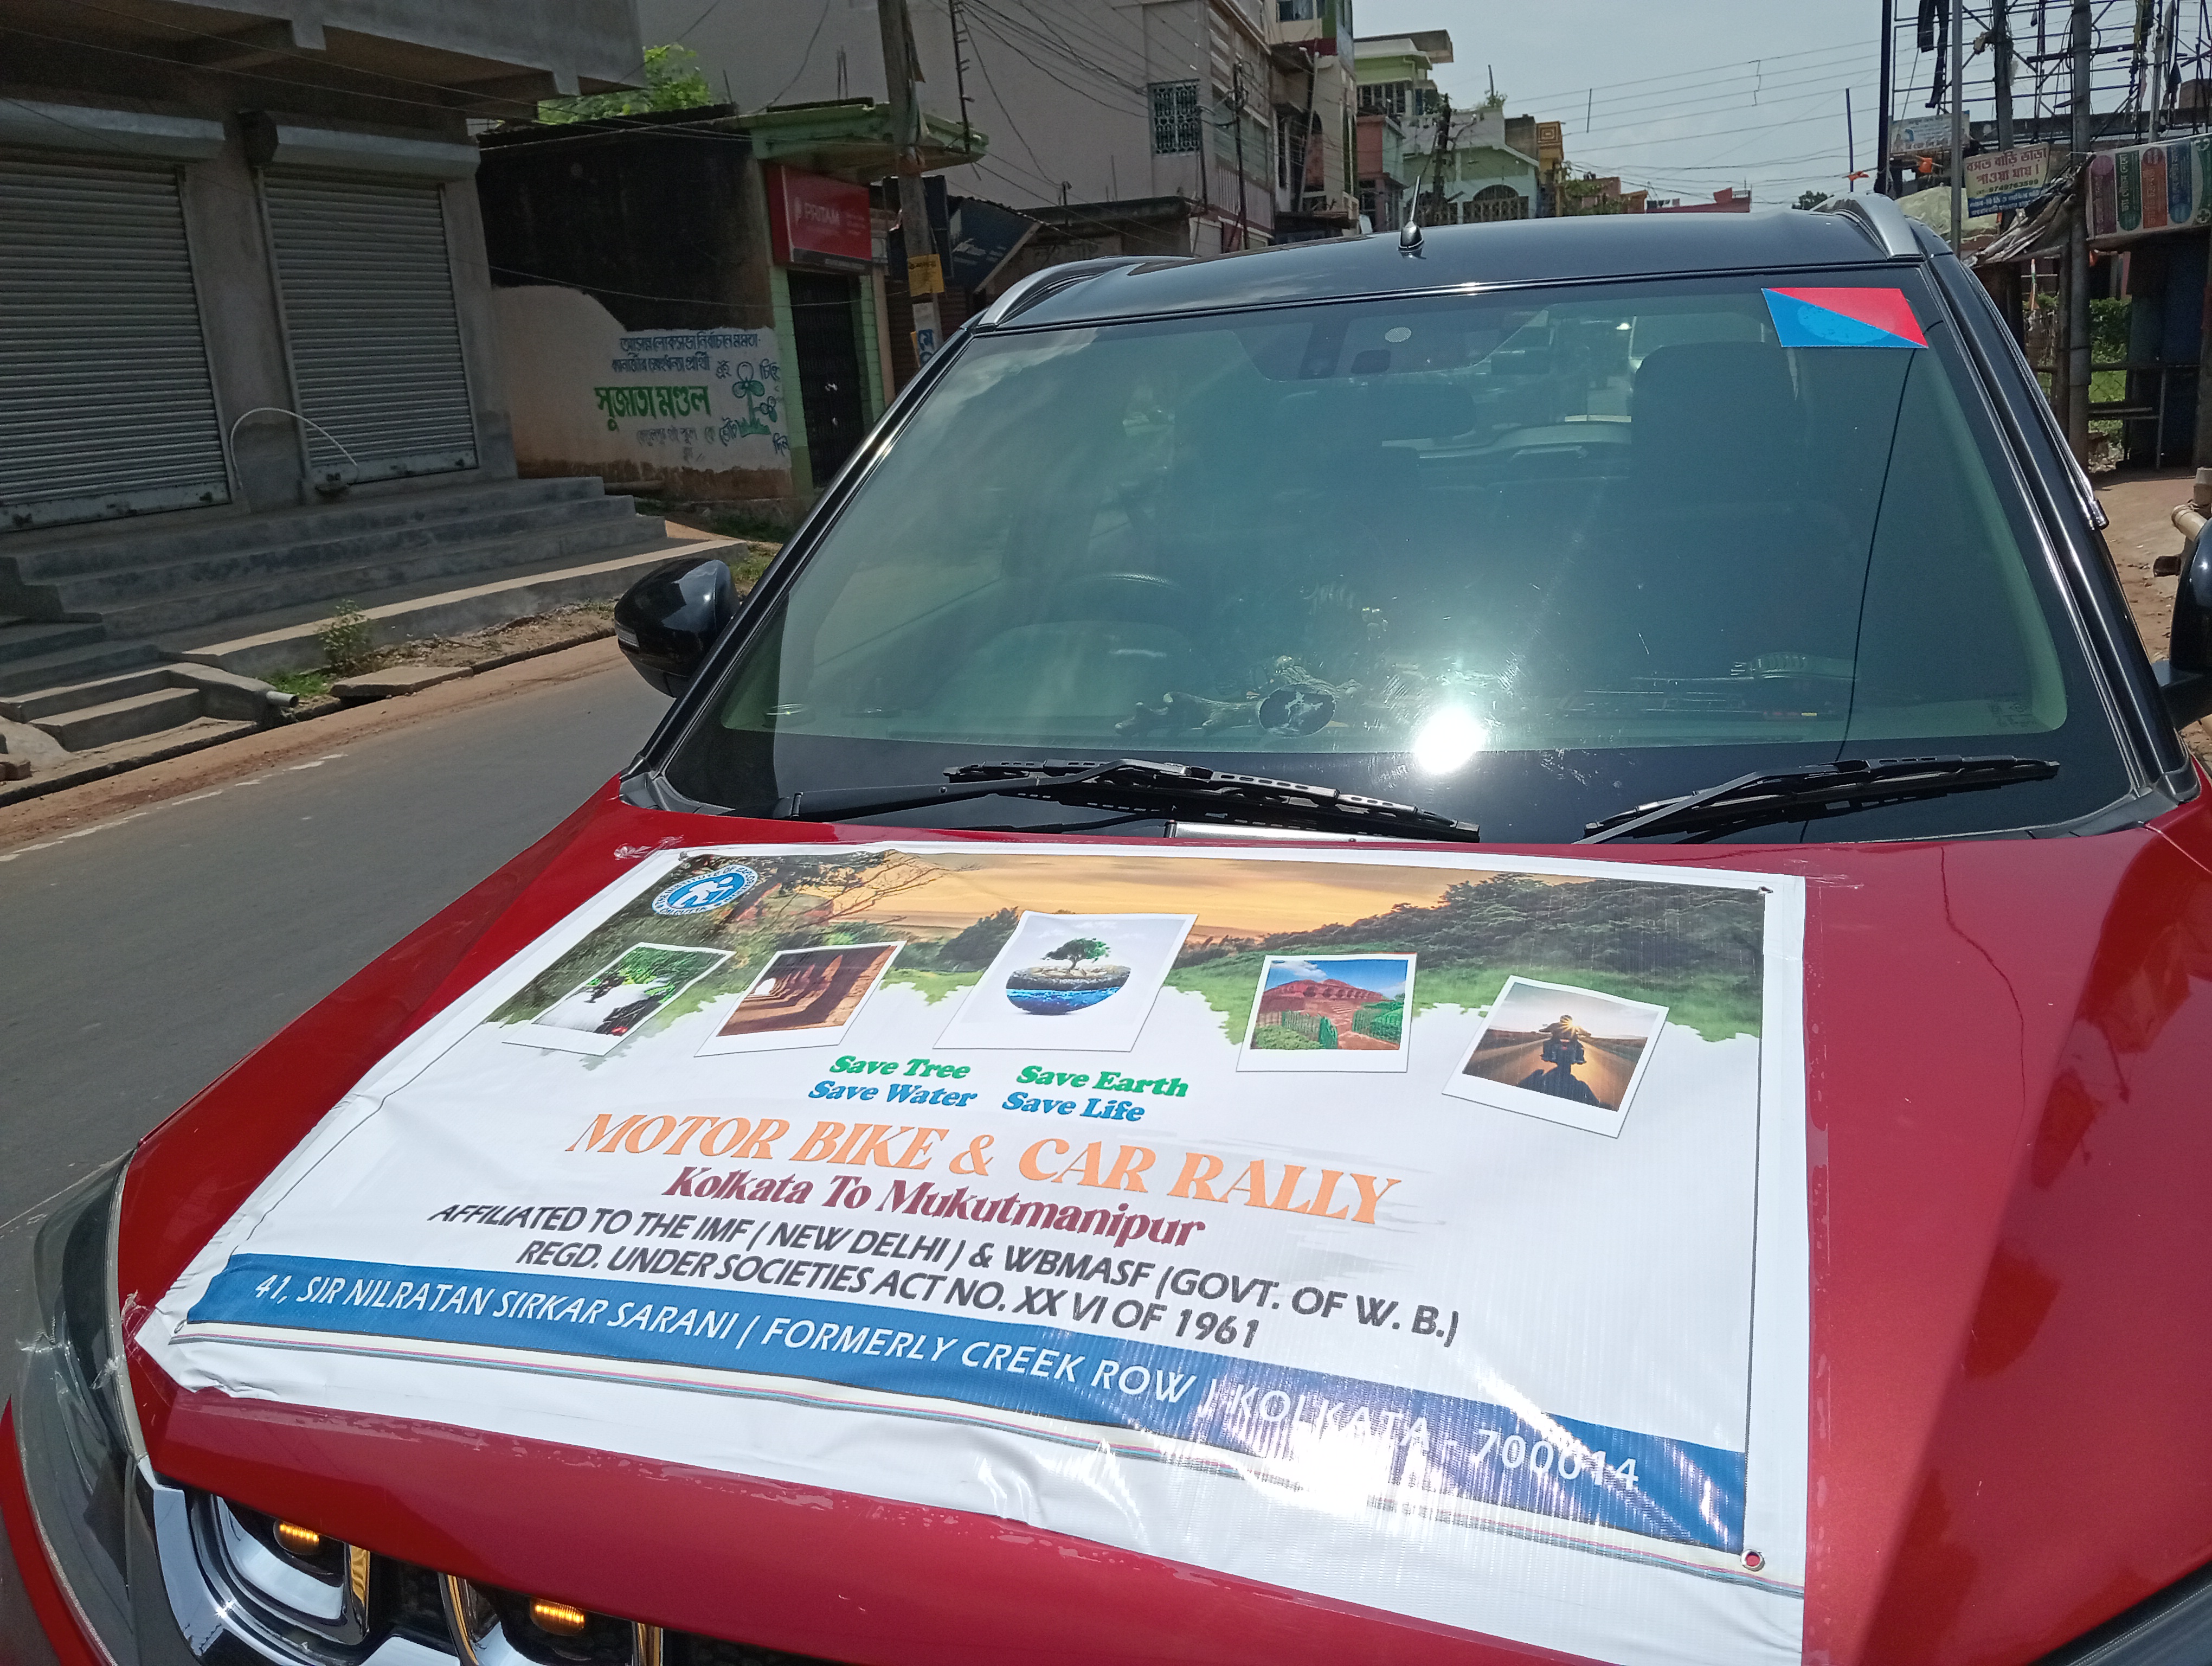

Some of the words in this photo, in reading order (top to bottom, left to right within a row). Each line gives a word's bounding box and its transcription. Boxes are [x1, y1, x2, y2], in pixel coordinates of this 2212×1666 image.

[594, 385, 657, 432] সুজাতা
[809, 1080, 879, 1100] Save
[886, 1084, 978, 1107] Water
[829, 1055, 899, 1076] Save
[902, 1057, 972, 1079] Tree
[1017, 1065, 1090, 1090] Save
[1092, 1072, 1189, 1098] Earth
[1002, 1092, 1076, 1116] Save
[1081, 1098, 1146, 1122] Life
[565, 1113, 790, 1159] MOTOR
[789, 1120, 950, 1170] BIKE
[949, 1134, 996, 1176] &
[1019, 1138, 1156, 1193] CAR
[1167, 1152, 1402, 1225] RALLY
[662, 1166, 814, 1204] Kolkata
[822, 1175, 872, 1209] To
[874, 1179, 1206, 1248] Mukutmanipur
[427, 1203, 588, 1235] AFFILIATED
[586, 1208, 633, 1235] TO
[633, 1210, 695, 1239] THE
[692, 1215, 755, 1242] IMF
[968, 1242, 993, 1268] &
[1004, 1245, 1156, 1288] WBMASF
[1155, 1265, 1281, 1310] (GOVT.
[1291, 1286, 1348, 1317] OF
[516, 1240, 600, 1268] REGD.
[607, 1246, 719, 1278] UNDER
[713, 1253, 874, 1293] SOCIETIES
[869, 1269, 948, 1302] ACT
[943, 1277, 1007, 1312] NO.
[1111, 1299, 1168, 1332] OF
[1175, 1309, 1260, 1349] 1961
[254, 1274, 289, 1304] 41,
[295, 1275, 348, 1304] SIR
[345, 1279, 496, 1316] NILRATAN
[491, 1289, 609, 1325] SIRKAR
[606, 1301, 741, 1341] SARANI
[761, 1317, 959, 1363] FORMERLY
[960, 1341, 1086, 1385] CREEK
[1090, 1359, 1197, 1404] ROW
[1229, 1383, 1431, 1453] KOLKATA
[1471, 1428, 1639, 1487] 700014
